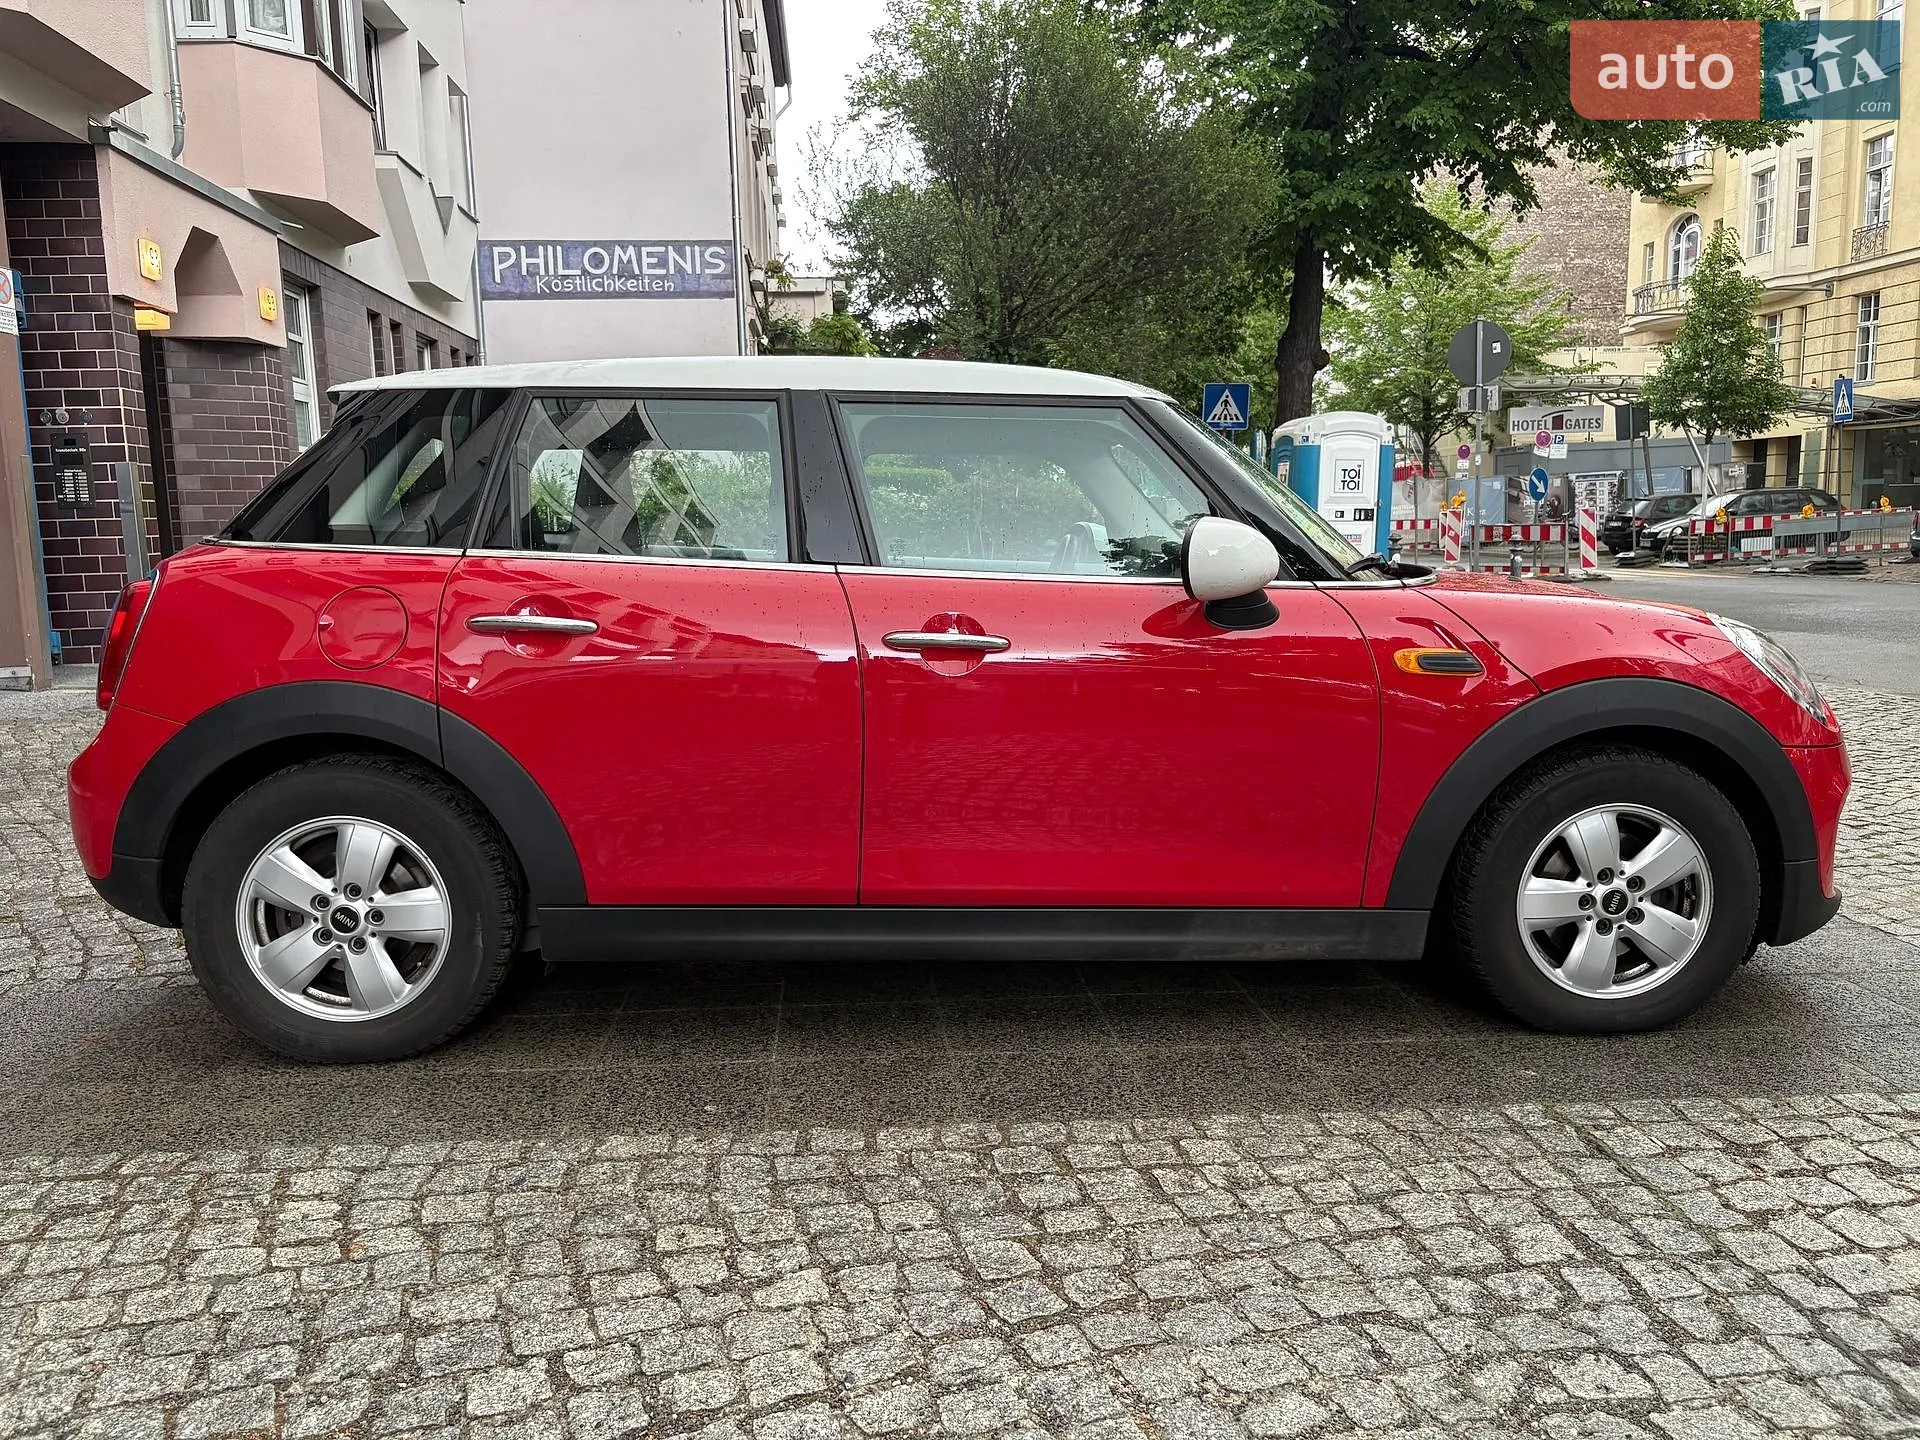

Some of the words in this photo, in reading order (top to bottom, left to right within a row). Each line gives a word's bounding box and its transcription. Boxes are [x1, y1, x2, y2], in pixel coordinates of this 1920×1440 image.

[493, 245, 726, 284] PHILOMENIS
[536, 274, 676, 295] Köstlichkeiten
[1511, 419, 1550, 431] HOTEL
[1564, 417, 1602, 430] GATES
[1341, 464, 1361, 479] TOI
[1340, 480, 1360, 490] TOI
[1608, 892, 1621, 912] MINI
[335, 911, 355, 928] MINI
